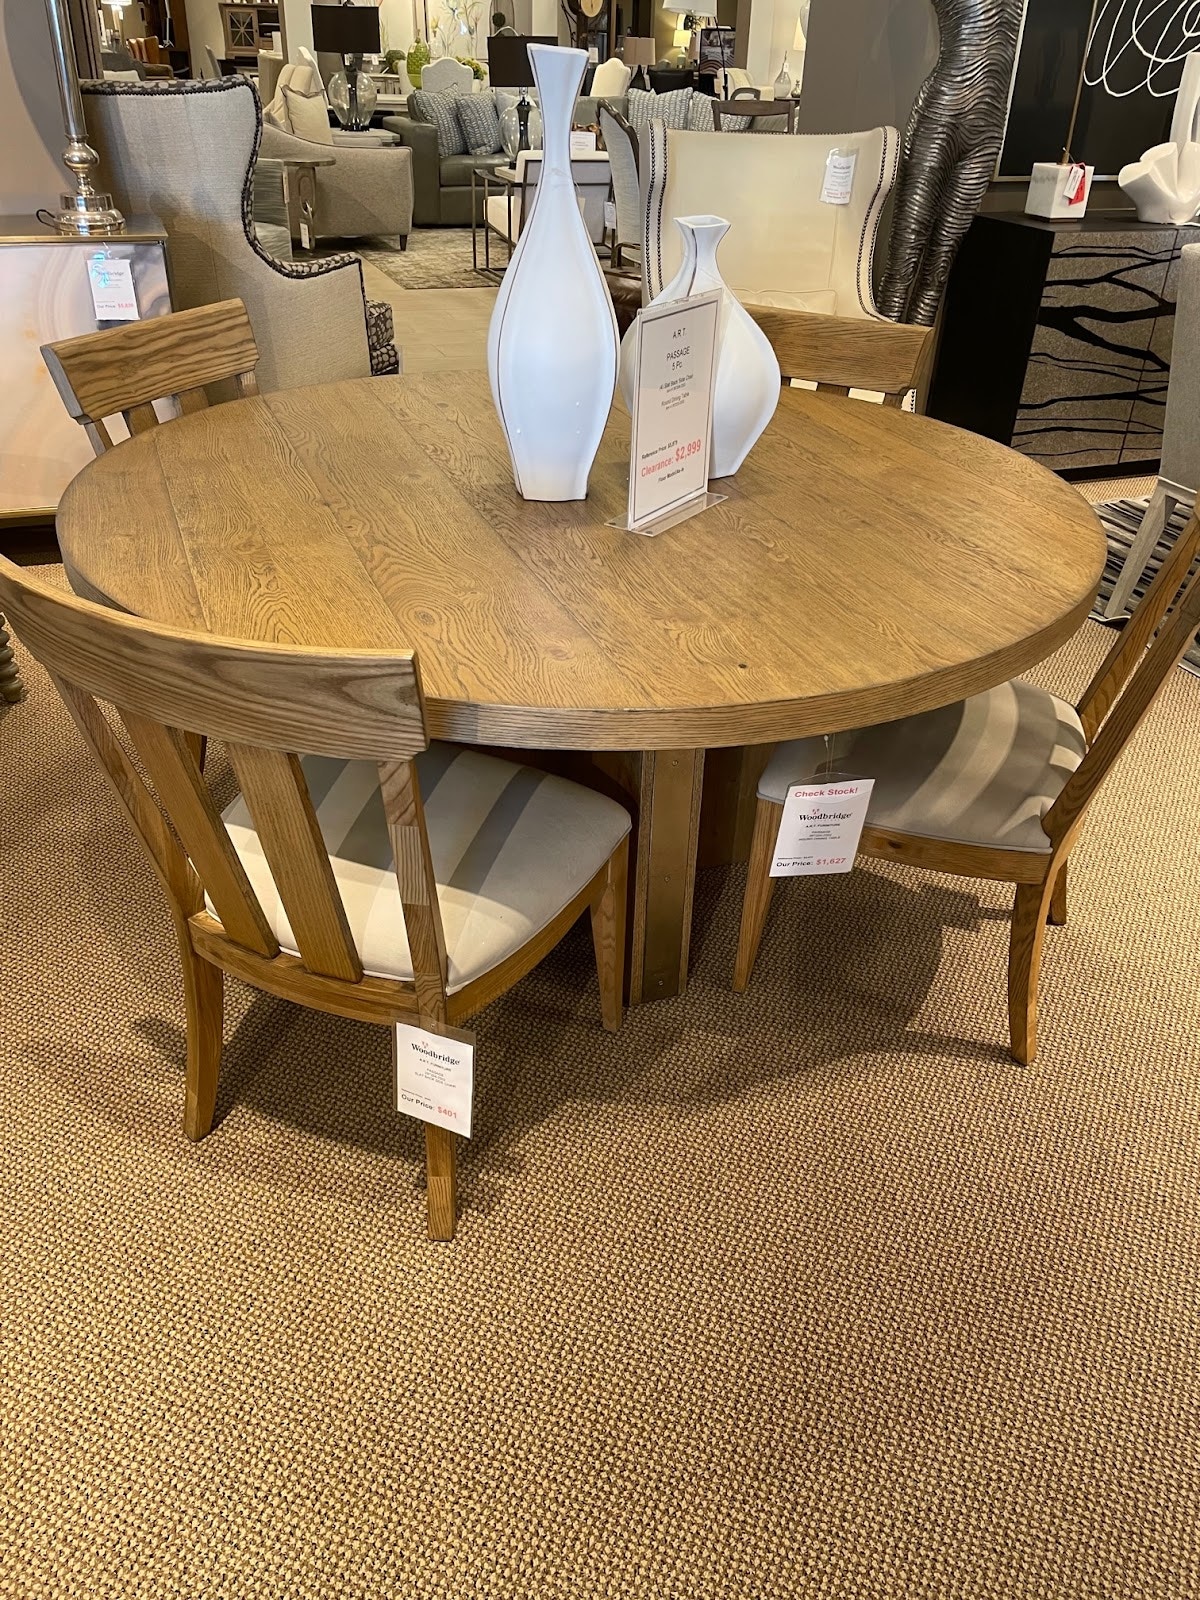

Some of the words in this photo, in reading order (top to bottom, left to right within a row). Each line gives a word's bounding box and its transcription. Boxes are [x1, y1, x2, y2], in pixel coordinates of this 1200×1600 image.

[666, 345, 690, 361] PASSAGE
[671, 362, 676, 371] 5
[641, 456, 674, 478] Clearance:
[675, 438, 702, 462] $2,999
[794, 789, 825, 798] Check
[827, 787, 858, 796] Stock!
[799, 812, 852, 821] Woodbridge
[816, 857, 847, 866] $1,627
[411, 1043, 460, 1066] Woodbridge
[401, 1093, 414, 1103] Our
[437, 1105, 457, 1119] $401
